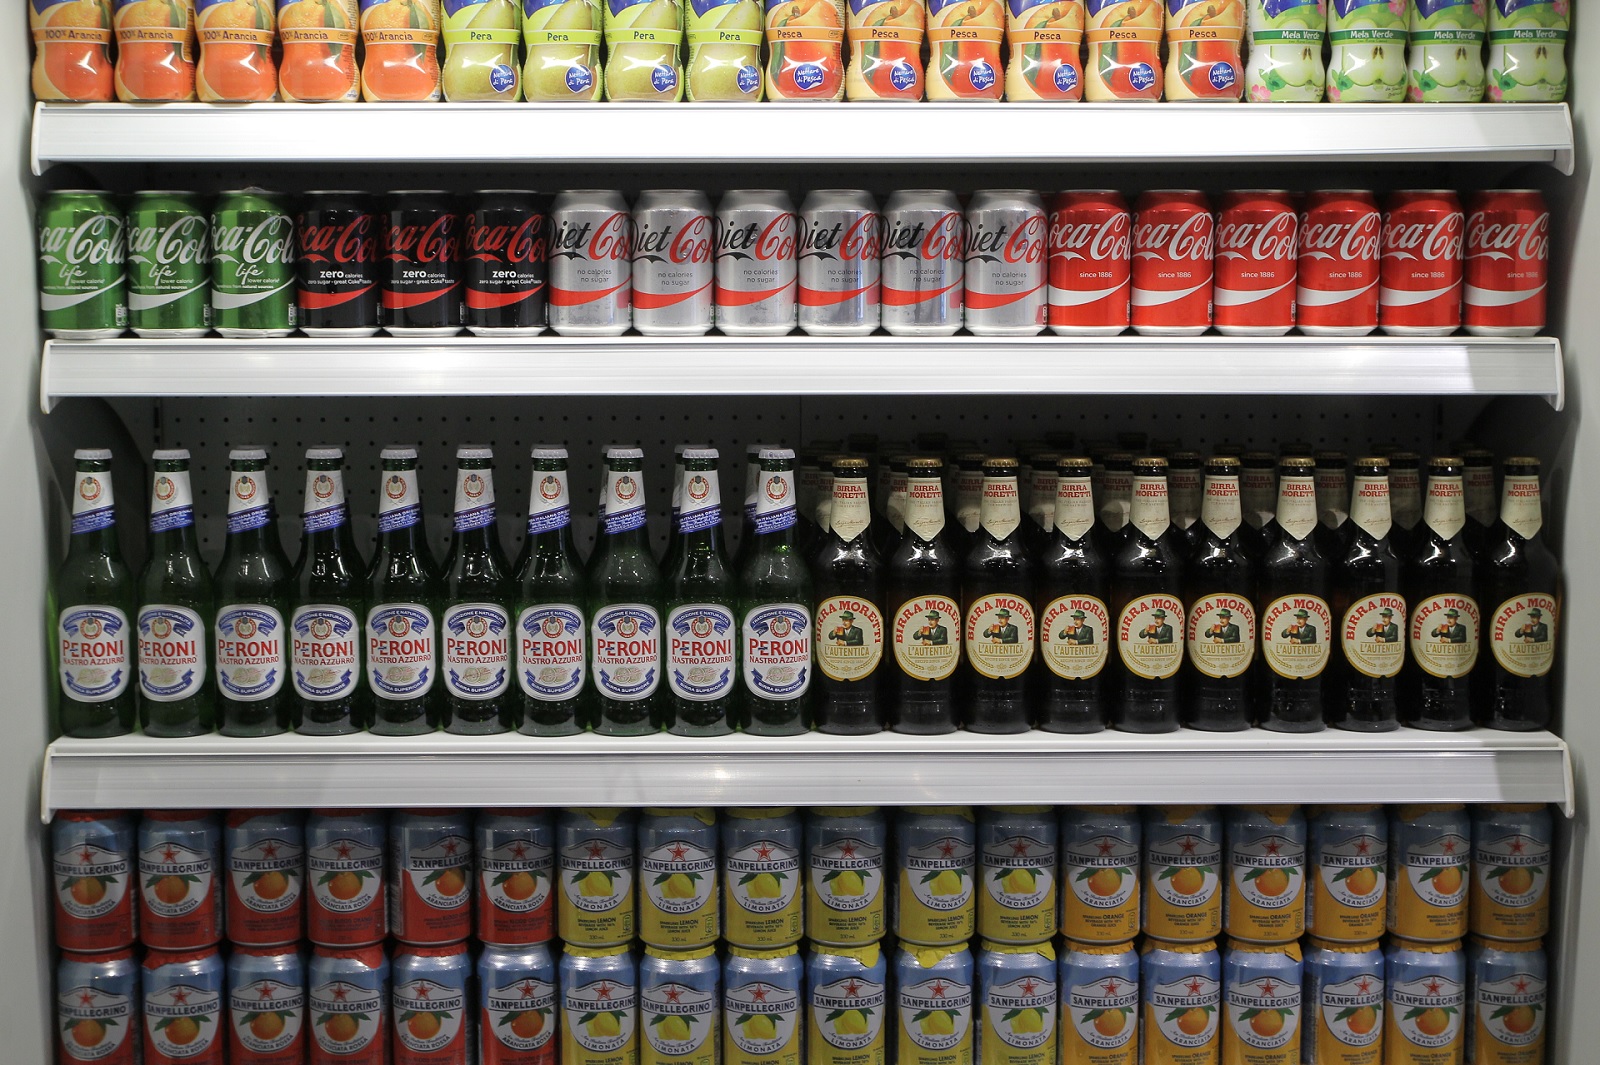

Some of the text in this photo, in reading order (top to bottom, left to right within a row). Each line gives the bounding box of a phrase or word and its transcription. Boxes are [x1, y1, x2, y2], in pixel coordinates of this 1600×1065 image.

[68, 30, 102, 40] Arancia
[138, 30, 173, 39] Arancia
[222, 31, 257, 41] Arancia
[294, 31, 328, 40] Arancia
[379, 31, 413, 41] Arancia
[470, 32, 492, 40] Pera
[547, 32, 568, 41] Pera
[634, 31, 655, 40] Pera
[720, 32, 740, 41] Pera
[778, 30, 802, 38] Pesca
[872, 30, 899, 38] Pesca
[950, 30, 978, 38] Pesca
[1034, 32, 1061, 40] Pesca
[1110, 30, 1137, 39] Pesca
[1189, 29, 1217, 38] Pesca
[1281, 31, 1320, 39] Mela Verde
[1351, 30, 1393, 39] Mela Verde
[1434, 31, 1476, 40] Mela Verde
[1513, 30, 1557, 39] Mela Verde
[803, 74, 822, 82] Pesca
[1138, 75, 1154, 84] Pesca
[1218, 74, 1234, 82] Pesca
[59, 264, 87, 286] life
[149, 264, 176, 286] life
[236, 263, 264, 285] life
[320, 270, 344, 278] zero
[403, 270, 426, 278] zero
[492, 270, 516, 278] zero
[672, 280, 690, 288] sugar
[816, 600, 882, 643] BIRRA MORETTI
[968, 598, 1033, 641] BIRRA MORETTI
[1265, 599, 1330, 641] BIRRA MORETTI
[63, 640, 124, 658] PERONI
[139, 640, 197, 657] PERONI
[218, 639, 278, 657] PERONI
[294, 640, 353, 657] PERONI
[371, 638, 431, 656] PERONI
[447, 638, 506, 656] PERONI
[523, 638, 582, 656] PERONI
[597, 638, 656, 656] PERONI
[672, 638, 732, 656] PERONI
[750, 638, 808, 656] PERONI
[825, 646, 870, 656] L'AUTENTICA
[978, 644, 1024, 654] L'AUTENTICA
[1200, 644, 1245, 653] L'AUTENTICA
[1276, 644, 1322, 654] L'AUTENTICA
[1426, 643, 1471, 653] L'AUTENTICA
[218, 656, 279, 665] NASTRO AZZURRO
[398, 654, 431, 663] AZZURRO
[523, 656, 582, 664] NASTRO AZZURRO
[672, 655, 732, 664] NASTRO AZZURRO
[750, 655, 808, 664] NASTRO AZZURRO
[311, 858, 380, 870] SANPELLEGRINO
[562, 858, 631, 870] SANPELLEGRINO
[729, 859, 798, 871] SANPELLEGRINO
[812, 857, 881, 870] SANPELLEGRINO
[1069, 854, 1137, 866] SANPELLEGRINO
[1235, 854, 1303, 866] SANPELLEGRINO
[644, 860, 713, 871] SANPELLEGRINO
[494, 895, 544, 910] ARANCIATA ROSSA
[576, 899, 618, 910] LIMONATA
[658, 900, 700, 912] LIMONATA
[744, 900, 786, 911] LIMONATA
[998, 896, 1040, 908] LIMONATA
[1084, 895, 1124, 907] ARANCIATA
[1251, 896, 1291, 907] ARANCIATA
[393, 998, 460, 1010] SANPELLEGRINO
[816, 994, 883, 1006] SANPELLEGRINO
[902, 995, 970, 1007] SANPELLEGRINO
[1231, 994, 1299, 1006] SANPELLEGRINO
[584, 1038, 625, 1050] LIMONATA
